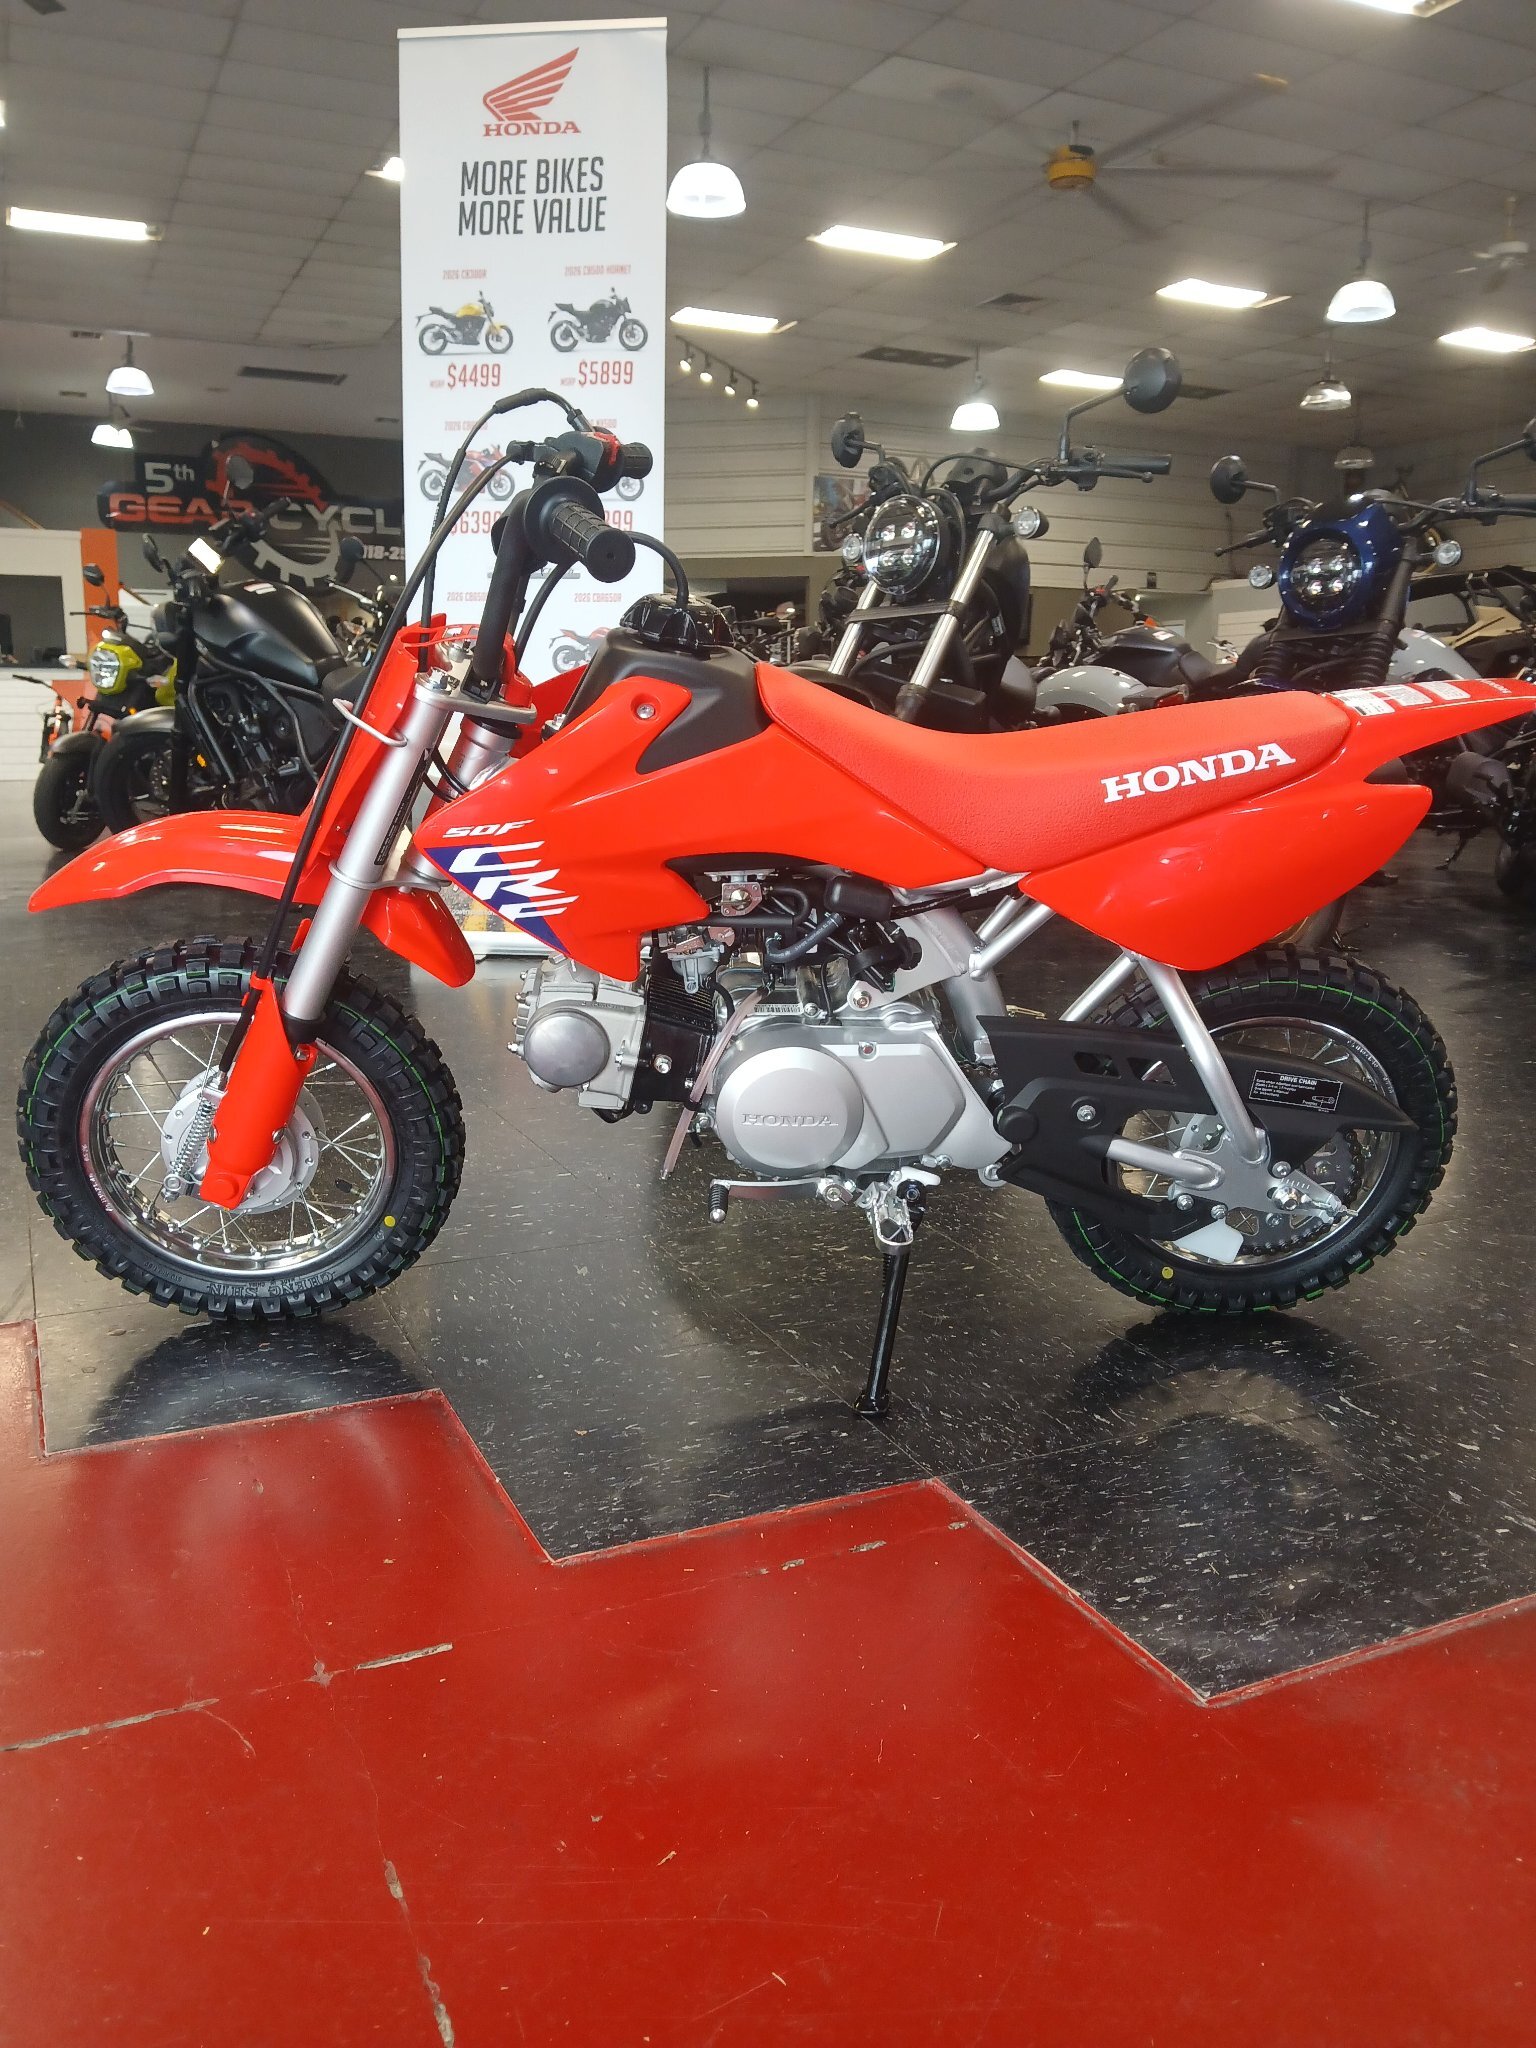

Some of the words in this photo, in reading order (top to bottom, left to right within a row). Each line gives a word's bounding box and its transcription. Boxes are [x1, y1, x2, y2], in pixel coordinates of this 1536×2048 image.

[483, 121, 581, 136] HONDA
[460, 160, 527, 197] MORE
[536, 157, 604, 193] BIKES
[458, 200, 523, 236] MORE
[534, 196, 607, 233] VALUE
[447, 362, 501, 390] $4499
[578, 359, 634, 388] $5899
[144, 461, 195, 493] 5th
[270, 502, 402, 535] CYCL
[1100, 743, 1296, 803] HONDA
[1280, 1075, 1298, 1083] DRIVE
[1299, 1078, 1318, 1086] CHAIN
[740, 1113, 839, 1127] HONDA
[207, 1283, 258, 1297] SHIN
[268, 1271, 335, 1297] CHENG
